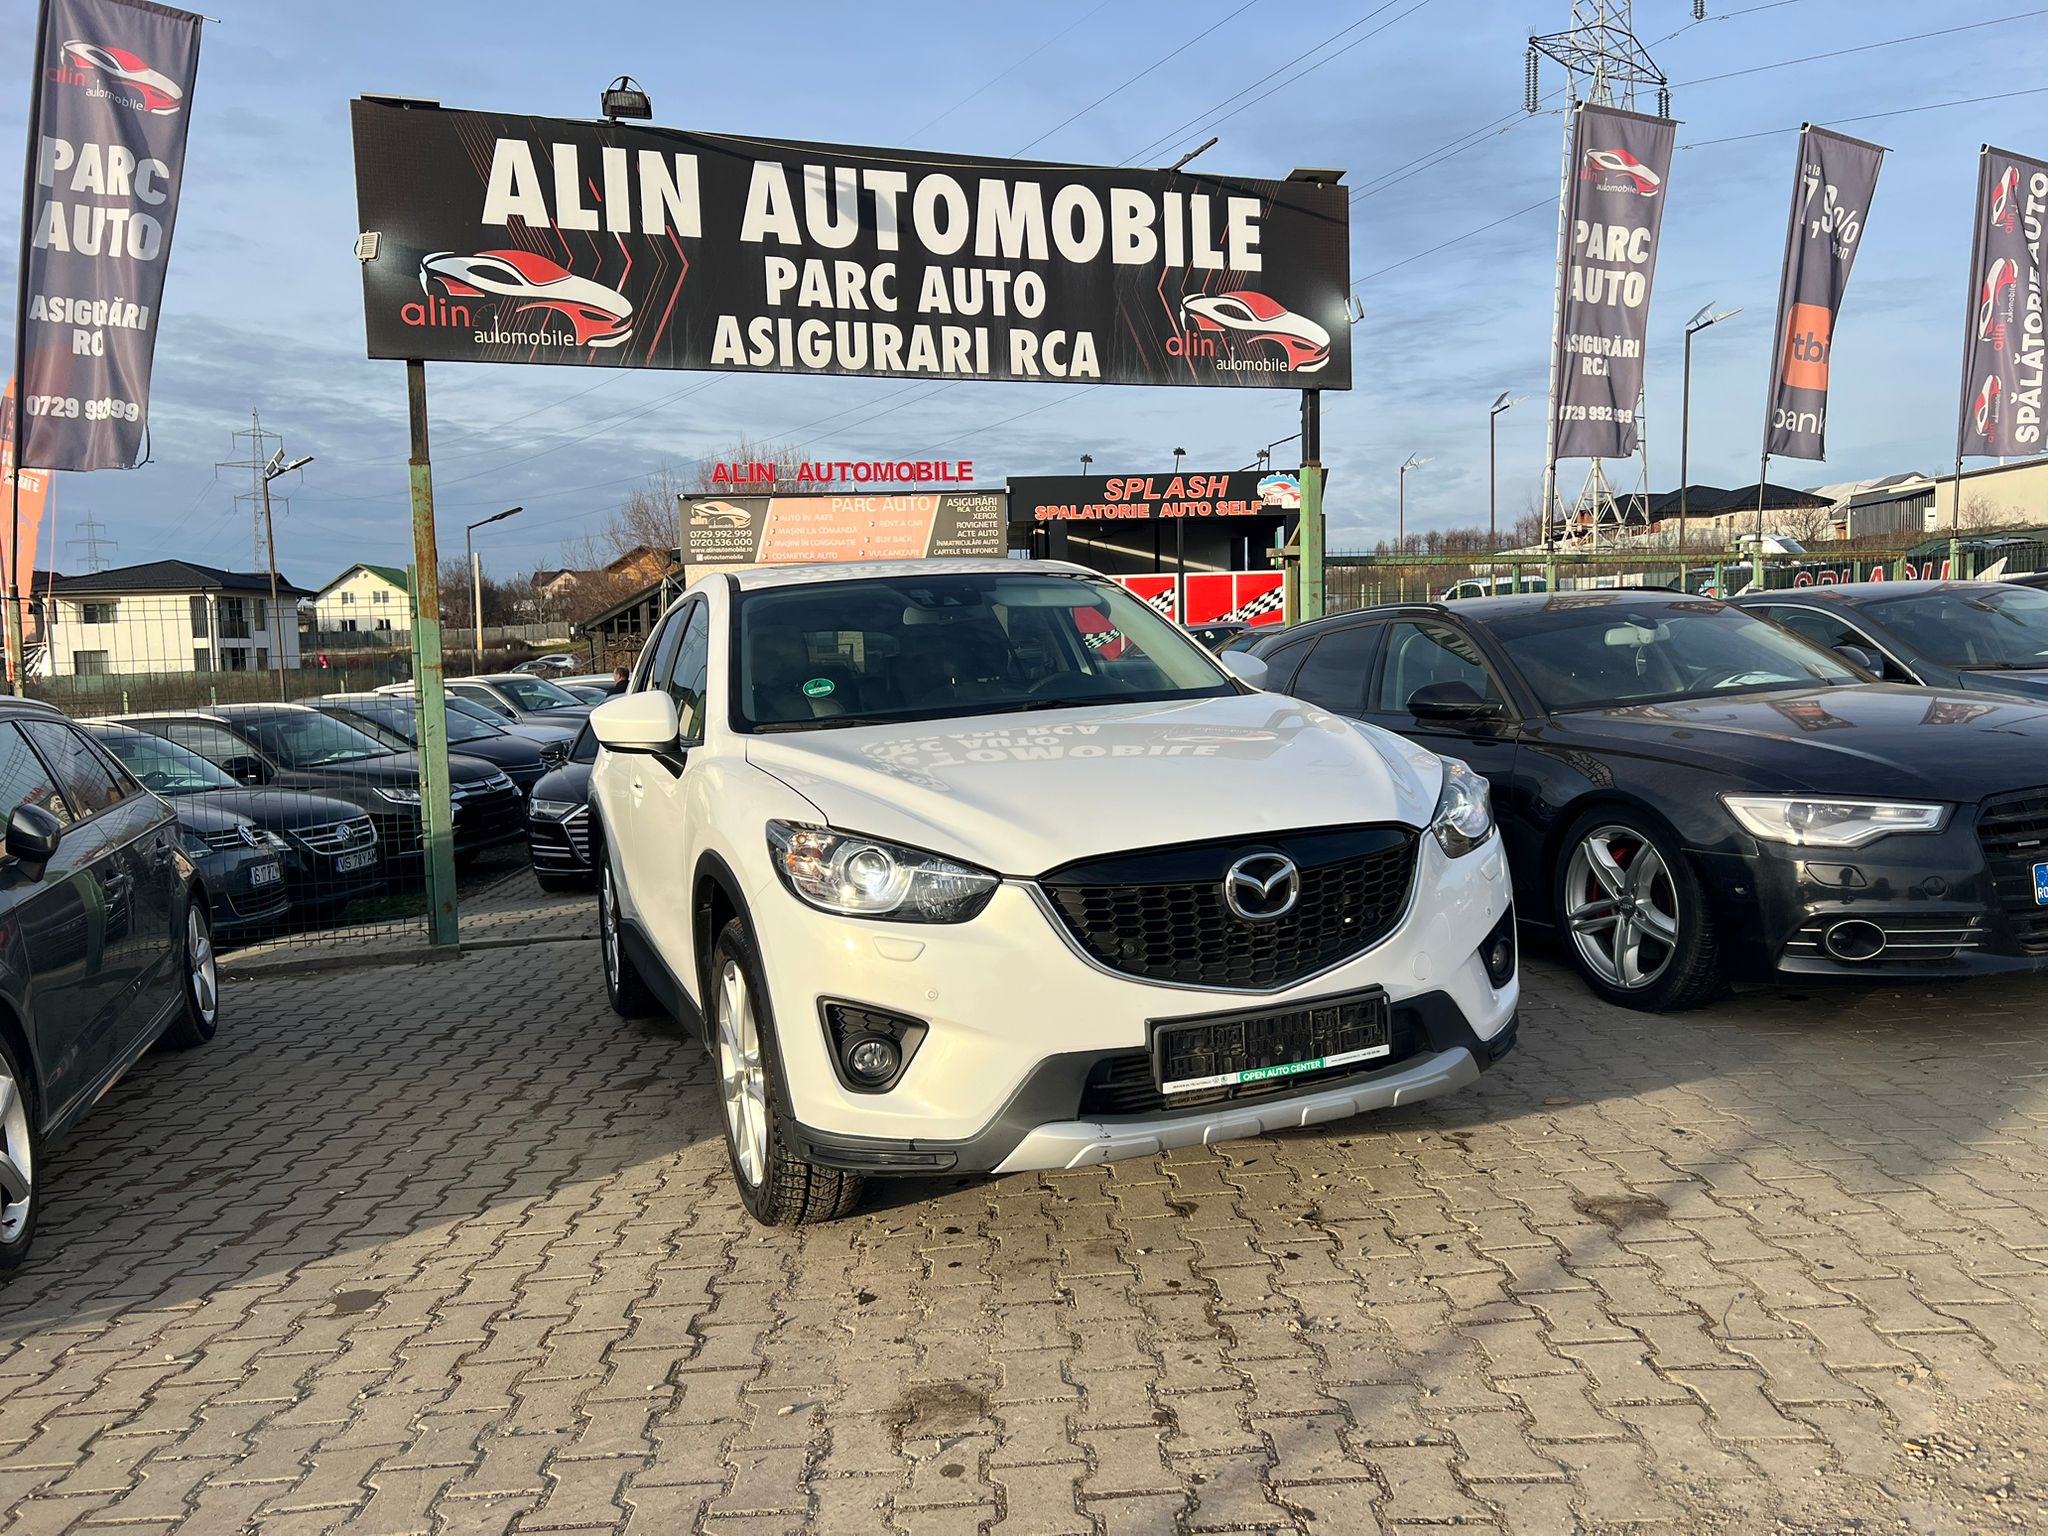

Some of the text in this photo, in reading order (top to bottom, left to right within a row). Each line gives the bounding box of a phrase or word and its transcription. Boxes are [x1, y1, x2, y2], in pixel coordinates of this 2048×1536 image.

[39, 135, 170, 205] PARC
[1812, 164, 1821, 176] la
[481, 138, 1263, 272] ALIN AUTOMOBILE
[2024, 172, 2048, 266] AUTO
[33, 201, 163, 261] AUTO
[1573, 219, 1651, 264] PARC
[765, 256, 1046, 319] PARC AUTO
[1569, 265, 1646, 308] AUTO
[401, 294, 470, 327] alin
[710, 315, 1100, 378] ASIGURARI RCA
[1165, 329, 1215, 357] alin
[1993, 322, 2007, 352] alin
[1792, 331, 1830, 365] tbi
[1582, 356, 1610, 377] RCA
[26, 395, 79, 419] 0729
[1588, 405, 1613, 421] 992
[712, 461, 974, 483] ALIN AUTOMOBILE
[1103, 475, 1230, 501] SPLASH
[832, 496, 931, 513] PARC AUTO
[946, 496, 998, 507] ASIGURĂRI
[1034, 500, 1263, 521] SPALATORIE AUTO SELF
[690, 516, 708, 525] alin
[956, 521, 998, 529] ROVIGNETE
[973, 512, 998, 520] XEROX
[689, 530, 752, 538] 0729.992.999
[690, 538, 753, 547] 0720.536.000
[957, 529, 999, 538] ACTE AUTO
[817, 551, 838, 559] AUTO
[962, 547, 998, 555] TELEFONICE
[2037, 886, 2048, 899] RO
[1243, 1060, 1321, 1081] OPEN AUTO CENTER
